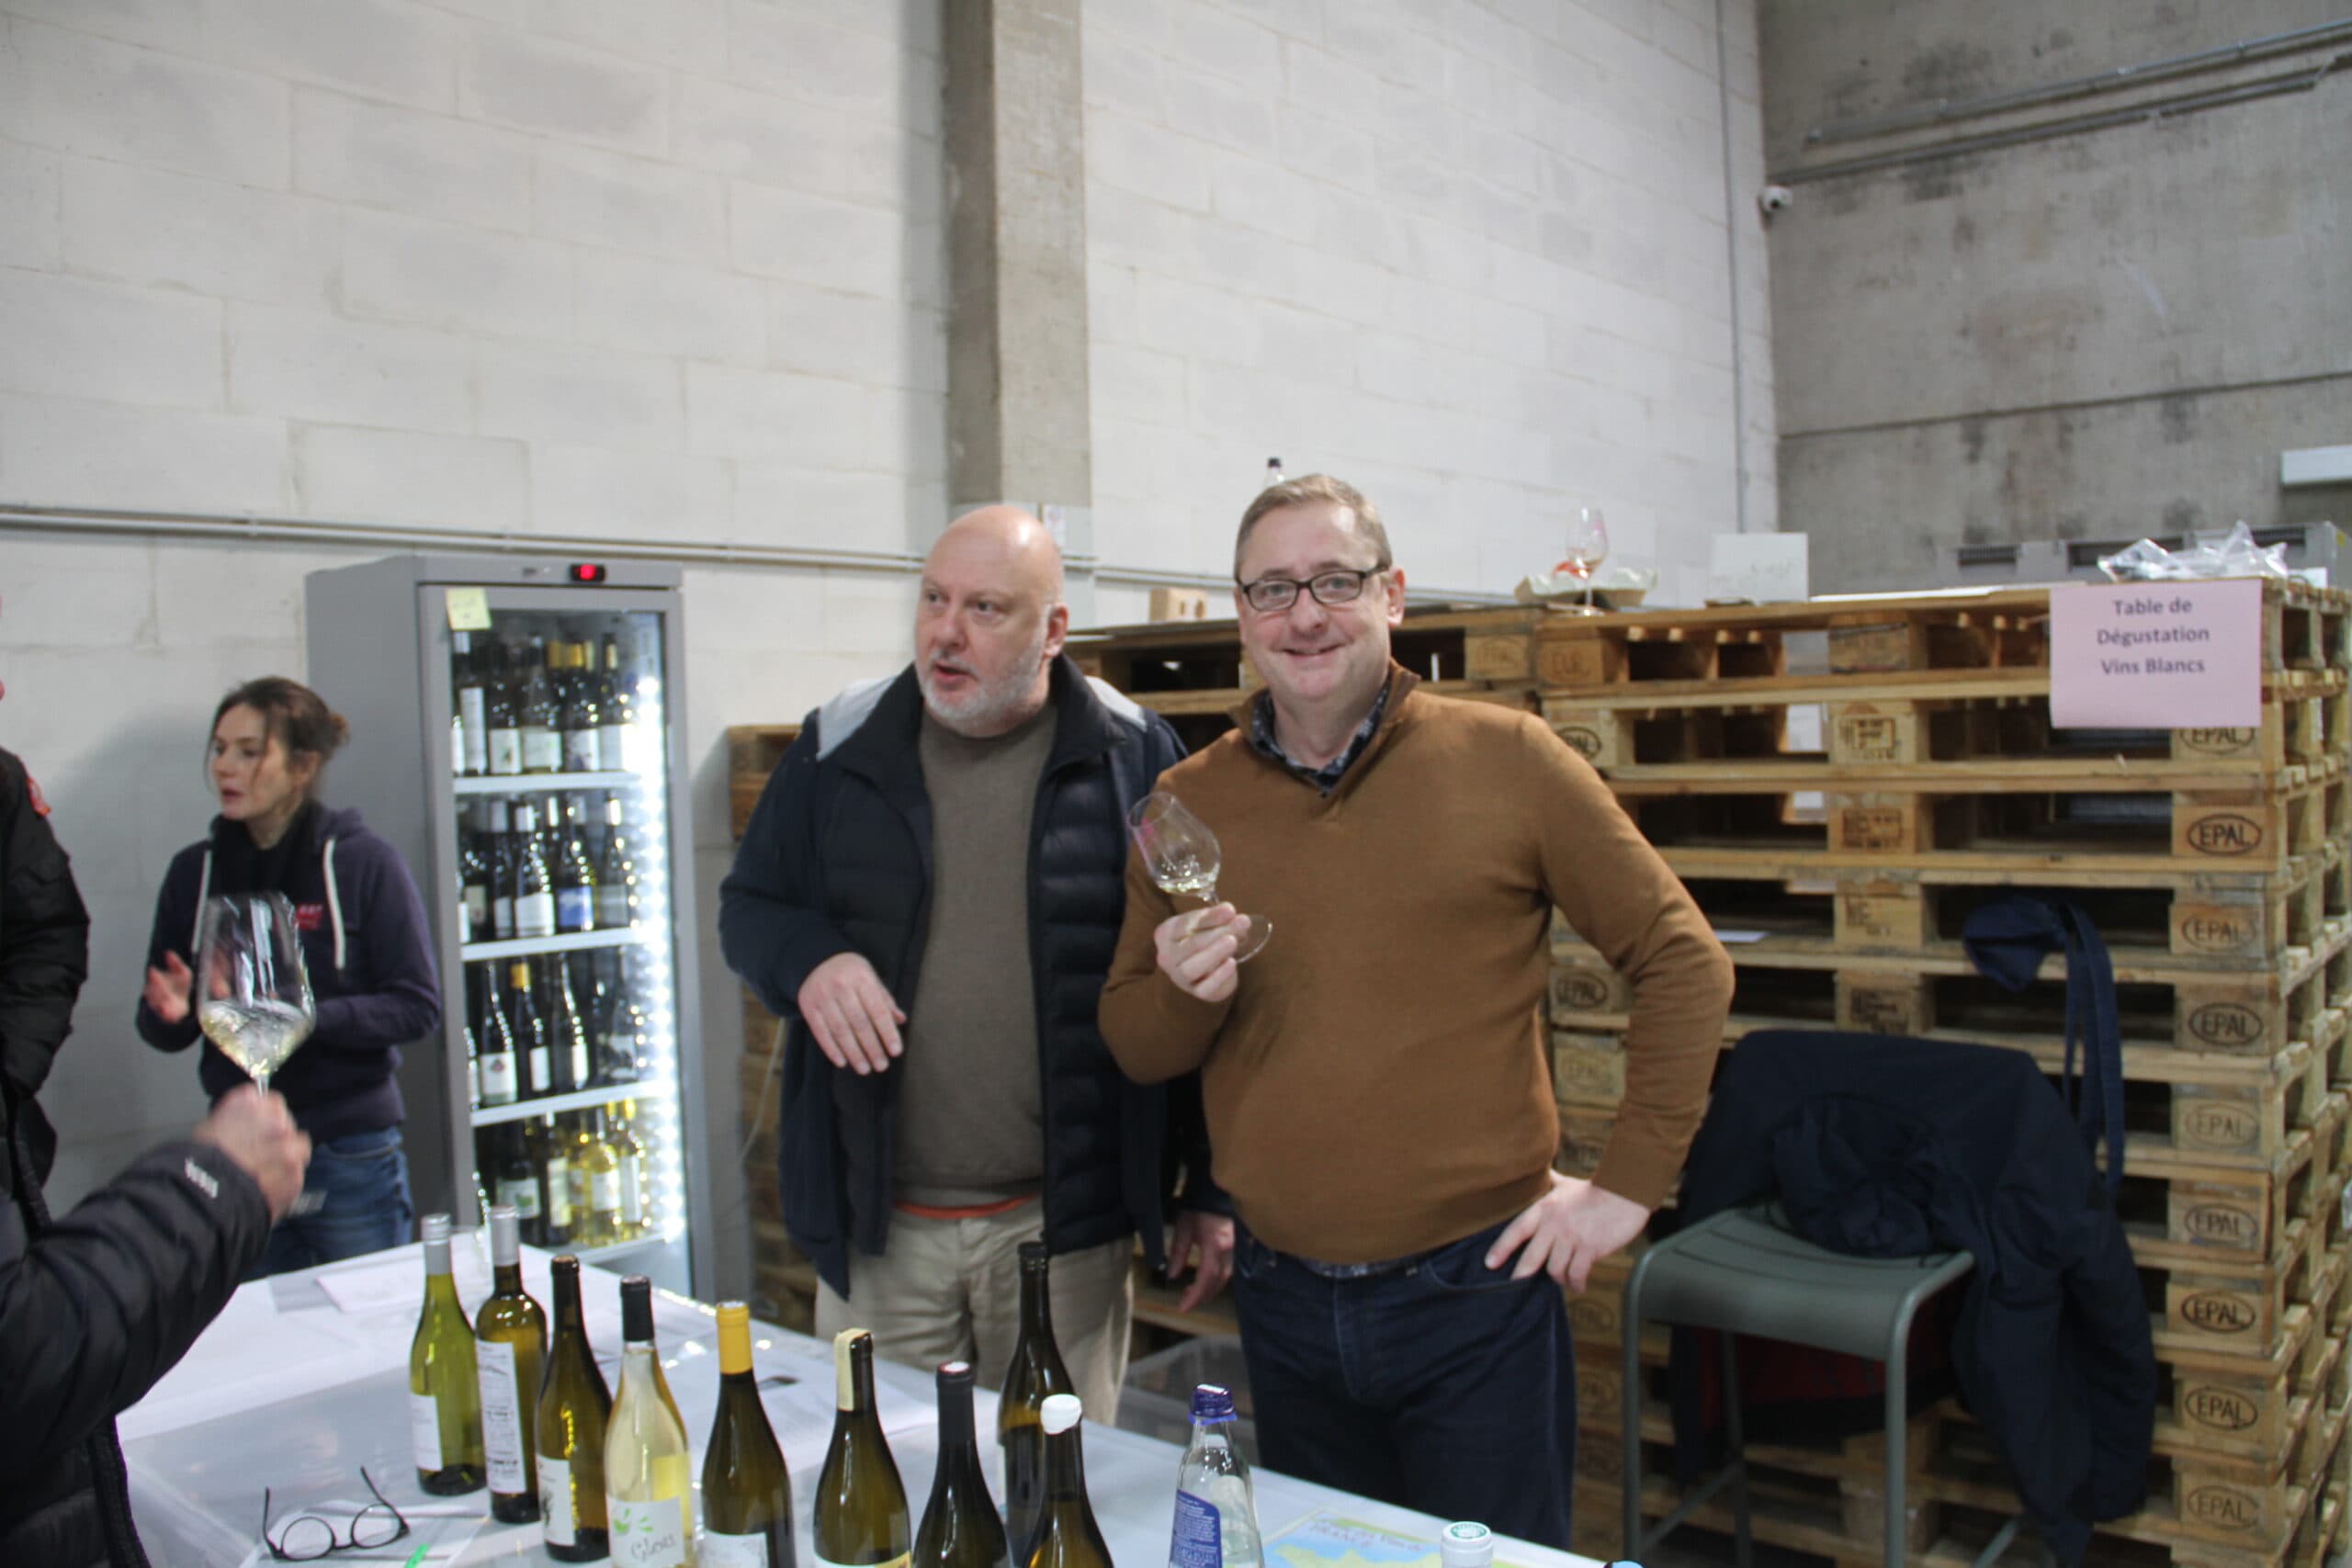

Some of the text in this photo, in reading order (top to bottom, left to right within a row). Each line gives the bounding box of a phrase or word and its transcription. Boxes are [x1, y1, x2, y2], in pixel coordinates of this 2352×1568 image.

[2114, 597, 2193, 615] Table de
[2097, 626, 2210, 647] Dégustation
[2101, 658, 2205, 675] Vins Blancs
[2199, 824, 2249, 846] EPAL
[2194, 921, 2243, 942] EPAL
[2200, 1015, 2248, 1038] EPAL
[2197, 1114, 2244, 1139] EPAL
[2194, 1210, 2242, 1235] EPAL
[2193, 1299, 2243, 1325] EPAL
[2197, 1393, 2244, 1421] EPAL
[2197, 1494, 2247, 1522] EPAL
